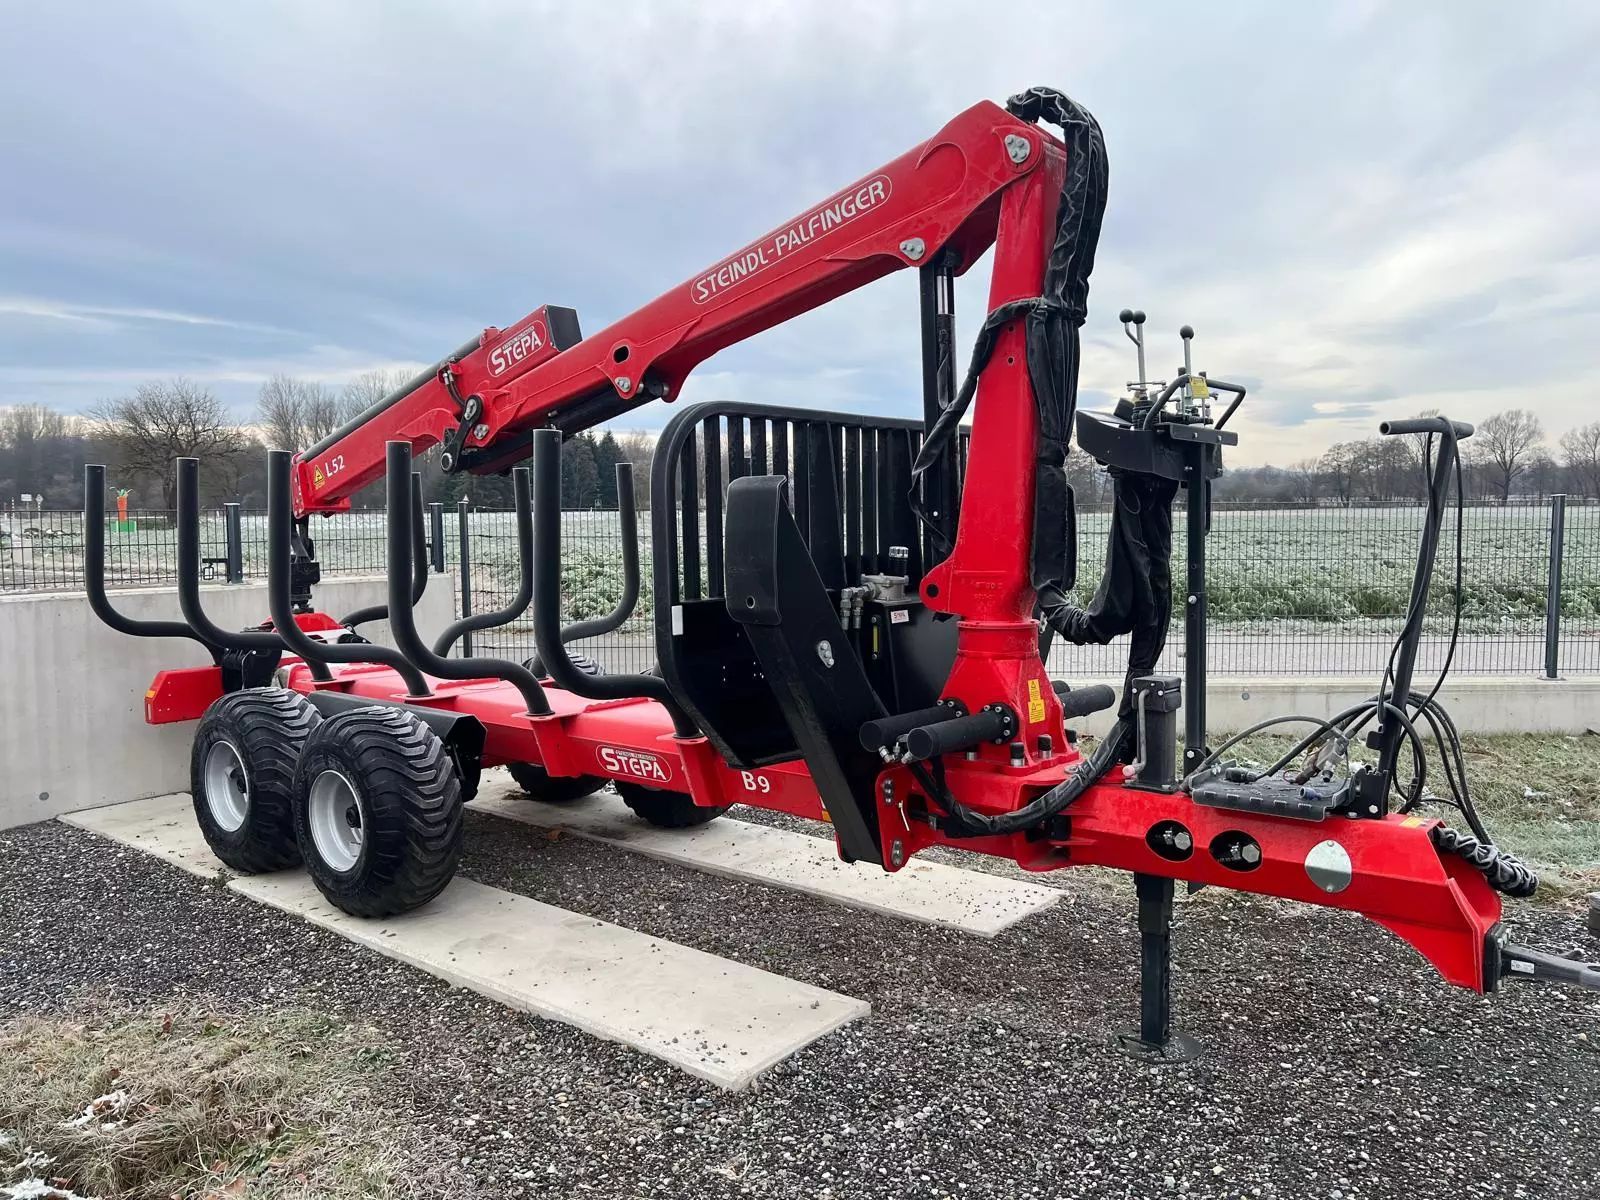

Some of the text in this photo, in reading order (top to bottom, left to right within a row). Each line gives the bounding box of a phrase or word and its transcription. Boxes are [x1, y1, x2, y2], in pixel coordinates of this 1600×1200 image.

[695, 180, 886, 301] STEINDL-PALFINGER
[491, 330, 542, 375] STEPA
[324, 454, 345, 478] L52
[601, 747, 667, 781] STEPA
